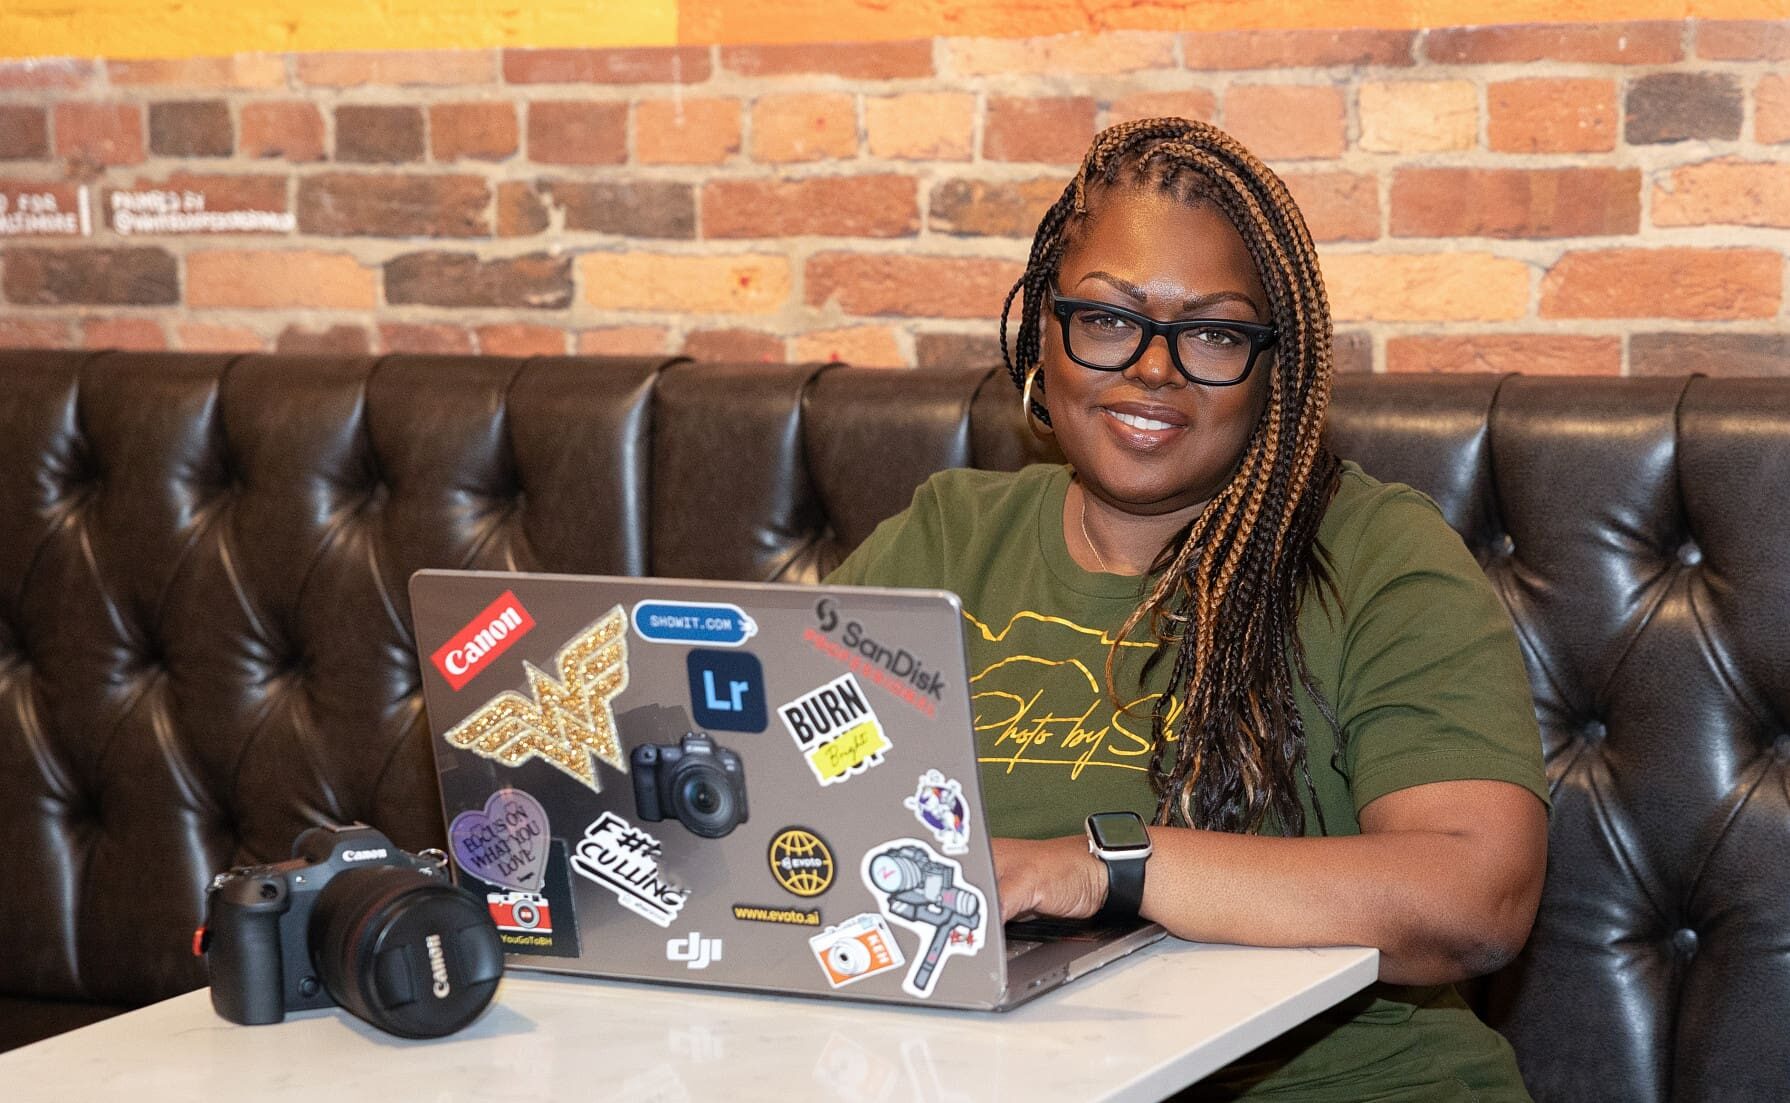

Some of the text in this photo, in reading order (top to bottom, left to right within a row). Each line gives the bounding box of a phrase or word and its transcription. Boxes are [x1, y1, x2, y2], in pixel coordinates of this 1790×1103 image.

[444, 605, 523, 676] Canon
[649, 614, 733, 631] SHOWIT.COM
[841, 620, 946, 700] SanDisk
[702, 669, 750, 713] Lr
[784, 678, 869, 745] BURN
[1060, 698, 1110, 780] by
[342, 848, 388, 862] Canon
[470, 819, 541, 869] WHAT YOU
[497, 848, 536, 877] LOVE
[580, 841, 685, 906] CULLING
[734, 906, 820, 926] www.evoto.ai
[425, 934, 451, 998] Canon
